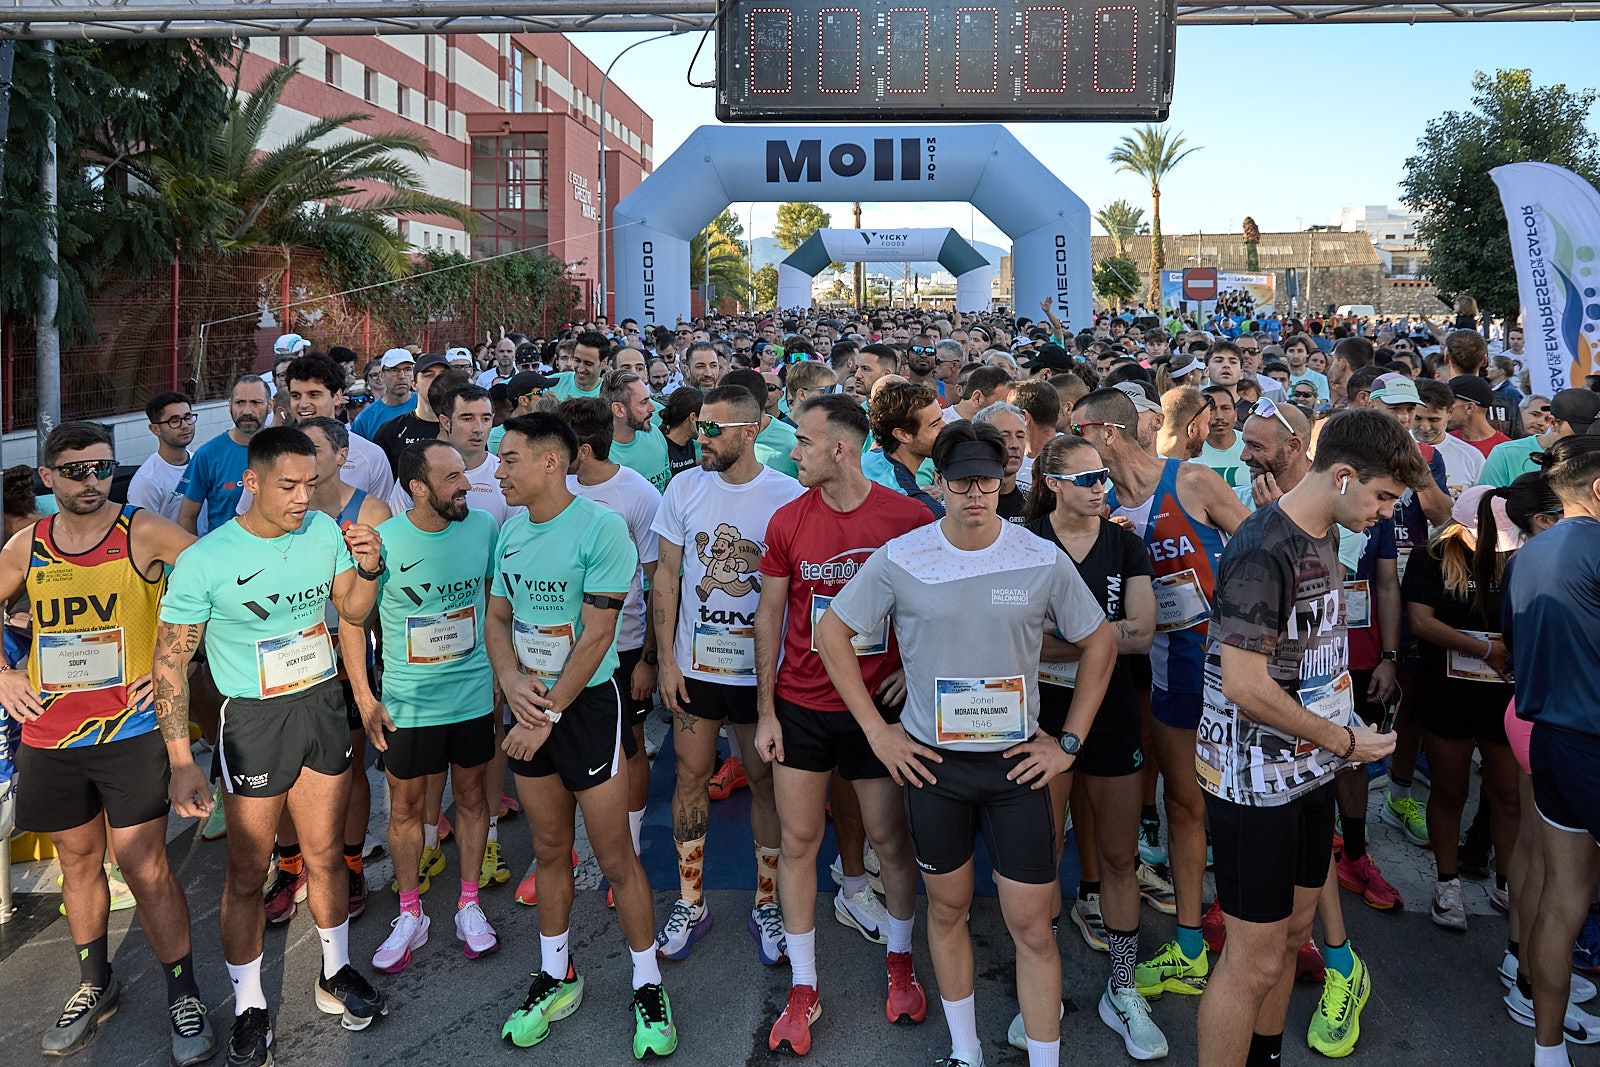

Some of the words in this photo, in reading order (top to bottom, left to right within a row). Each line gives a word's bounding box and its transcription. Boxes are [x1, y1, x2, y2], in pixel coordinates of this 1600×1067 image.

[766, 138, 921, 183] Moll
[926, 137, 936, 181] MOTOR
[1147, 535, 1195, 561] ESA
[800, 558, 864, 580] tecnóv
[436, 576, 481, 595] VICKY
[524, 580, 568, 592] VICKY
[285, 580, 331, 605] VICKY
[441, 589, 476, 603] FOODS
[529, 593, 565, 603] FOODS
[291, 595, 331, 613] FOODS
[36, 593, 118, 628] UPV
[1162, 609, 1182, 620] 2020
[434, 625, 456, 634] Ferran
[429, 634, 443, 643] VICKY
[443, 632, 458, 641] FOODS
[716, 638, 737, 648] Quino
[58, 649, 100, 659] Alejandro
[733, 648, 745, 656] TANO
[285, 657, 300, 667] VICKY
[300, 652, 316, 662] FOODS
[717, 656, 734, 665] 1677
[67, 670, 89, 679] 2274
[970, 696, 994, 705] Johel
[954, 707, 980, 716] MORATAL
[980, 706, 1008, 715] PALOMINO
[971, 719, 992, 729] 1546
[246, 772, 269, 783] VICKY
